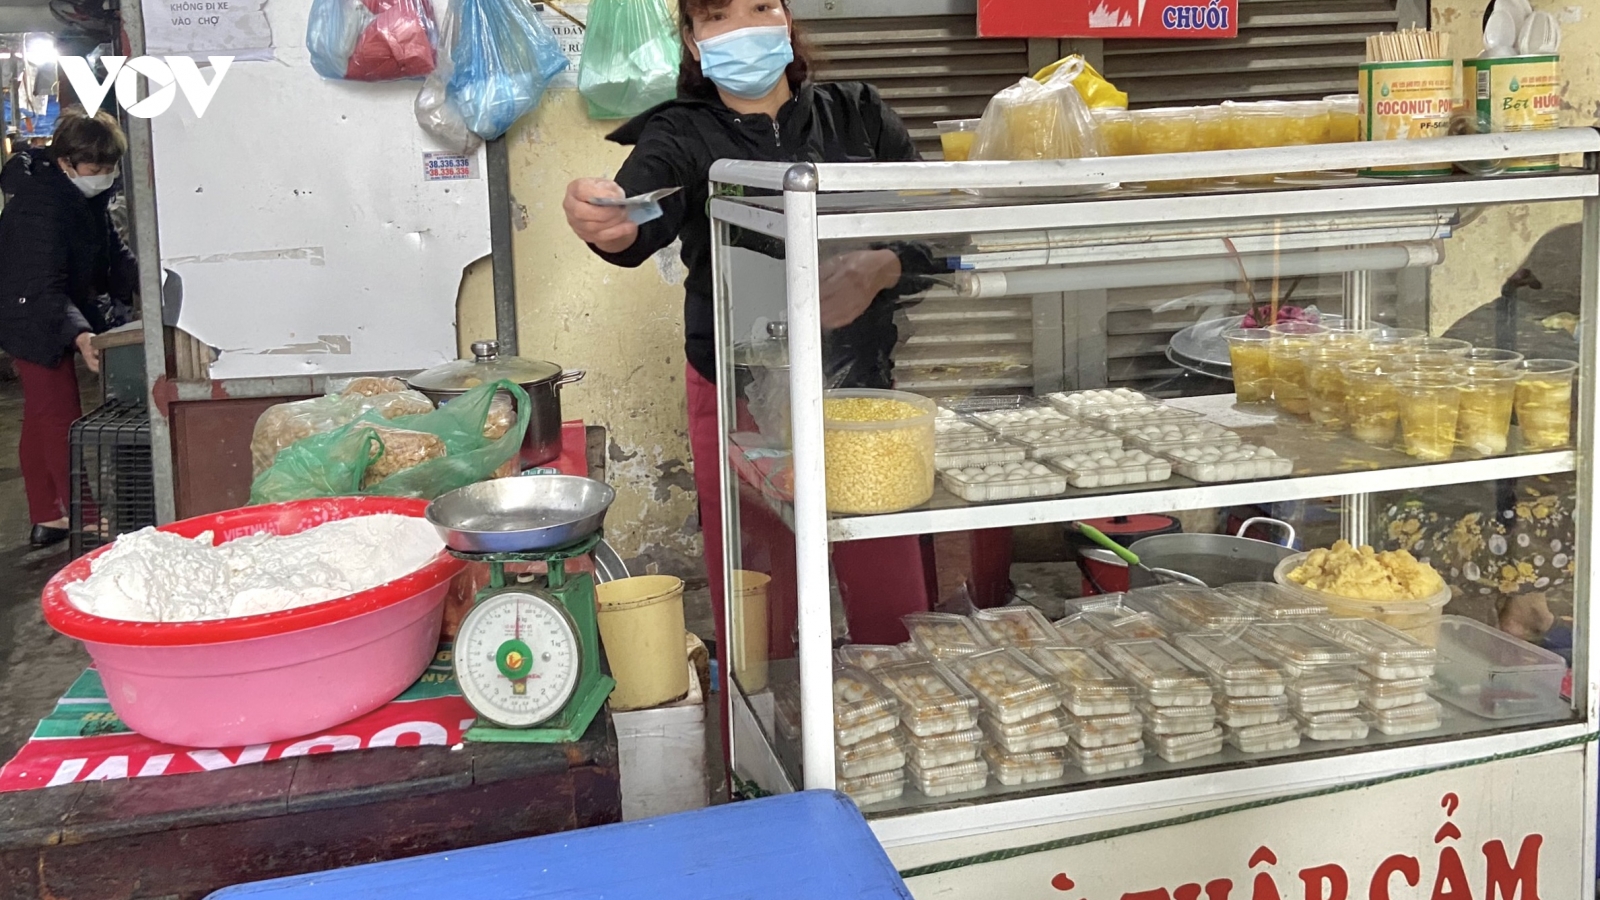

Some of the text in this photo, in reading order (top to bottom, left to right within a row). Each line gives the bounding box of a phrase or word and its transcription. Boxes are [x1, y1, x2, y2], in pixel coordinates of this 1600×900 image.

[170, 1, 229, 12] KHÔNG ĐI XE
[171, 16, 220, 26] VÀO CHỢ
[1162, 0, 1229, 29] CHUỐI
[1376, 99, 1433, 115] COCONUT
